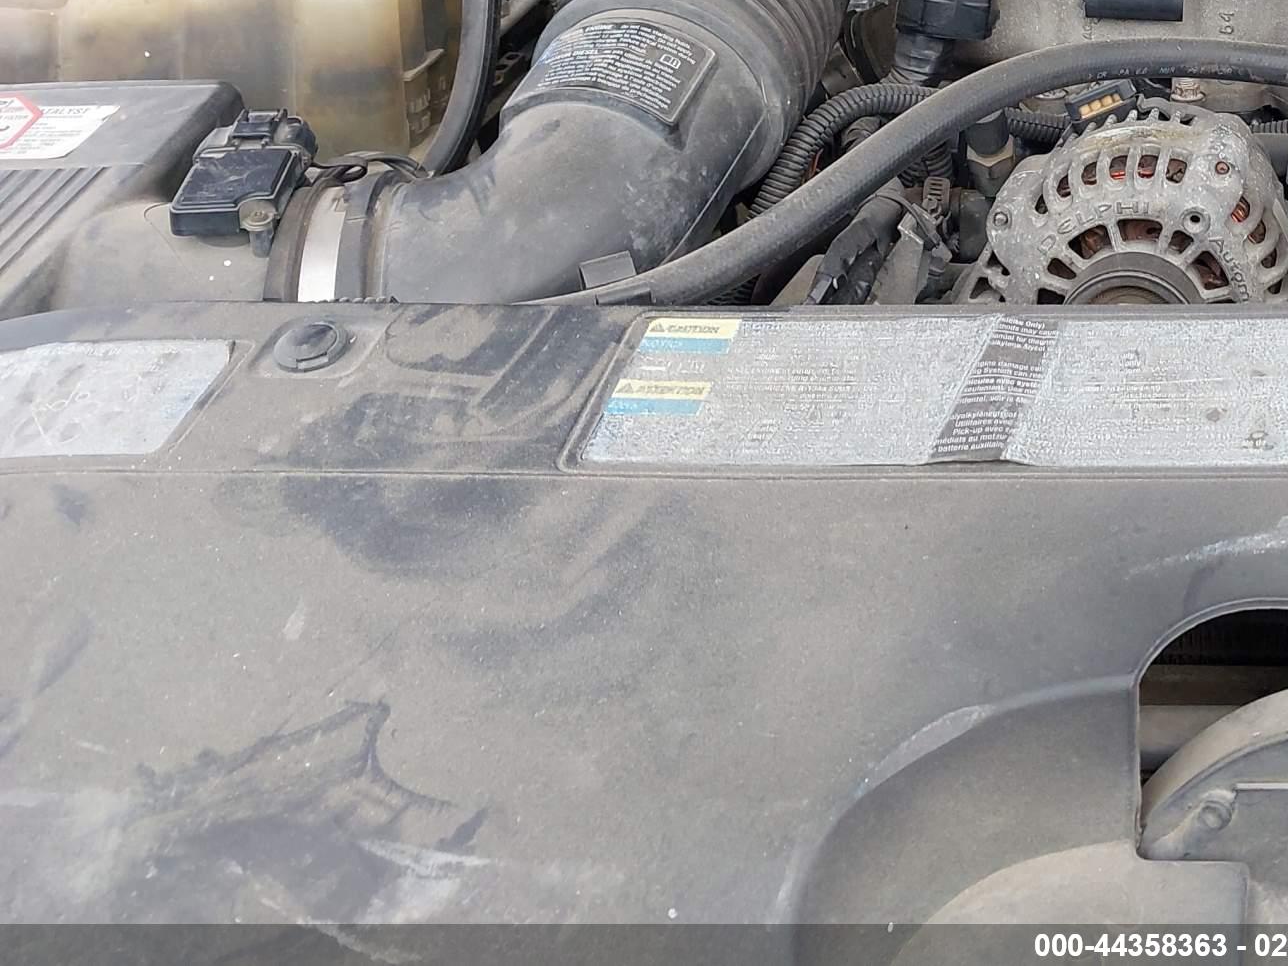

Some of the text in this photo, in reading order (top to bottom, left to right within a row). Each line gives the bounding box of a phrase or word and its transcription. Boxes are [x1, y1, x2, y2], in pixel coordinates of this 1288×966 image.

[1037, 201, 1150, 255] DELPHI
[1025, 320, 1045, 330] Only)
[1020, 327, 1037, 336] may
[997, 360, 1028, 370] damage
[953, 425, 1003, 437] Pick-up avec
[938, 444, 969, 453] batterie
